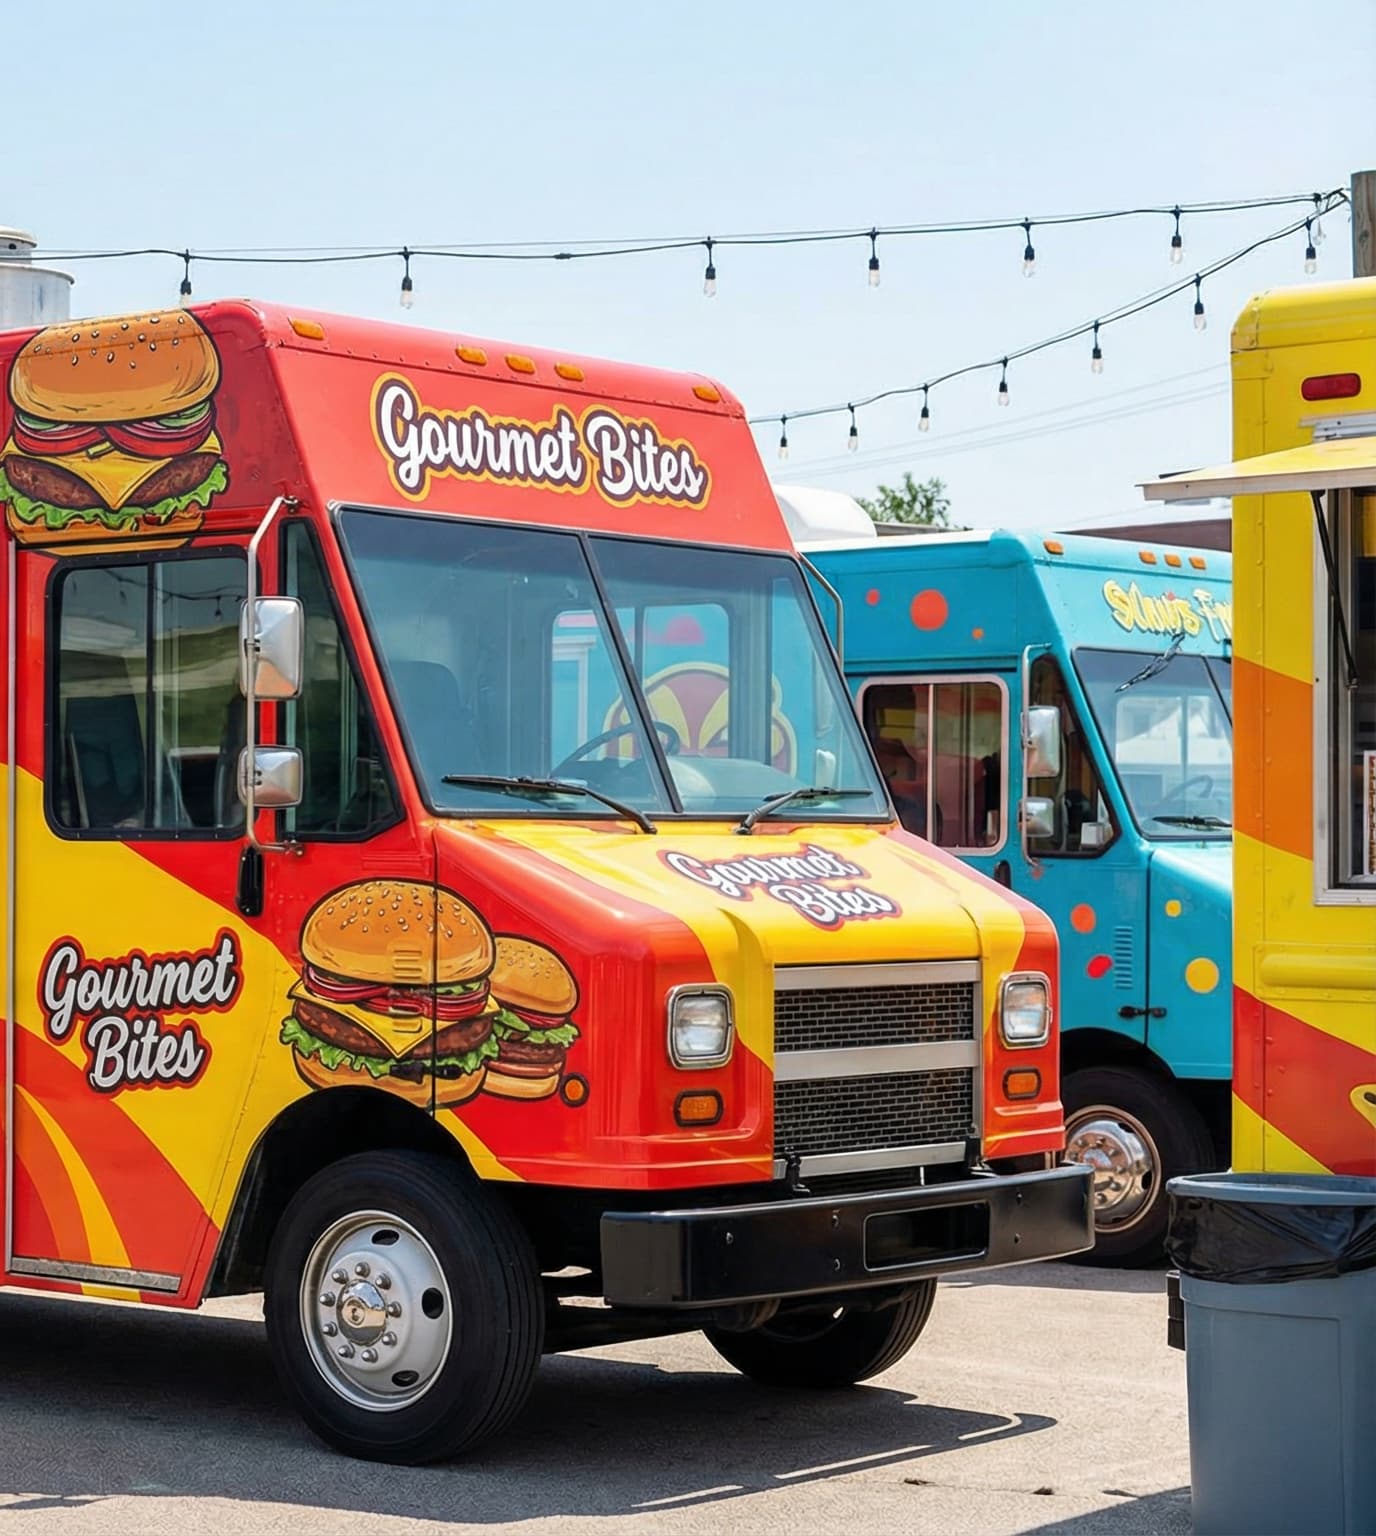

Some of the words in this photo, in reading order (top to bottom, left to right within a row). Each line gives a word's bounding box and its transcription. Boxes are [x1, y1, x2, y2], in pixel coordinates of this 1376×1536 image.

[379, 385, 583, 489] Gourmet
[587, 415, 705, 499] Bites
[666, 845, 860, 897] Gourmet
[769, 884, 894, 923] Bites
[45, 938, 236, 1035] Gourmet
[87, 1016, 204, 1088] Bites
